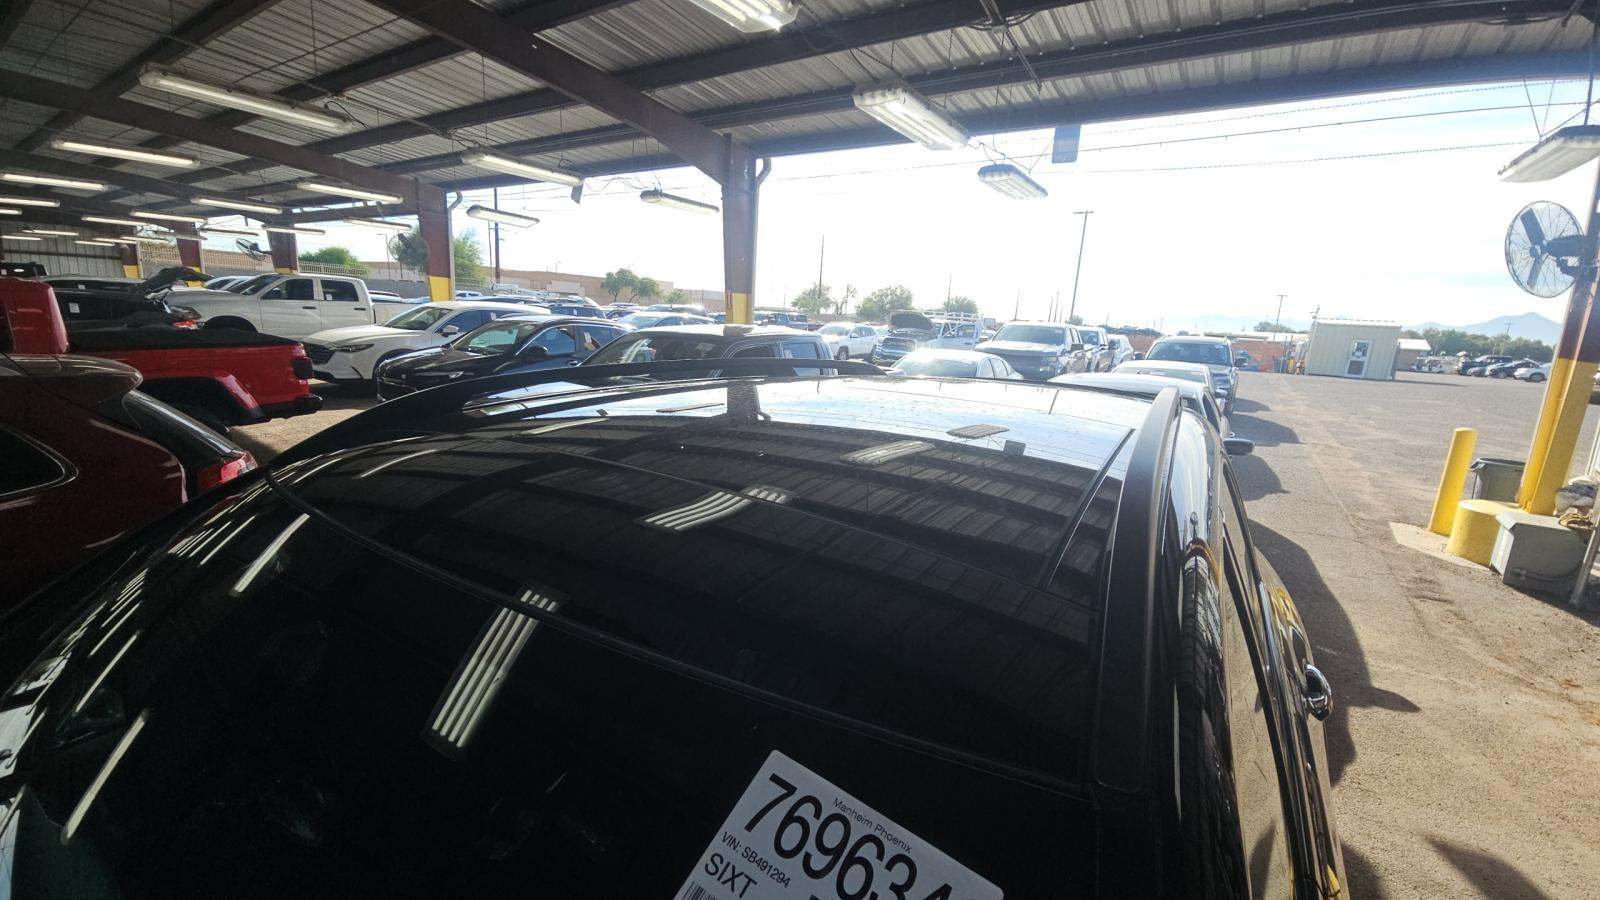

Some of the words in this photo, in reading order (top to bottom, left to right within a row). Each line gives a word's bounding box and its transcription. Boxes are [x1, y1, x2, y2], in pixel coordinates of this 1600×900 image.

[744, 773, 952, 900] 76963
[833, 797, 873, 829] Manheim
[874, 823, 912, 853] Phoenix
[704, 852, 758, 898] SIXT
[722, 831, 742, 853] VIN:
[741, 846, 791, 888] SB491294
